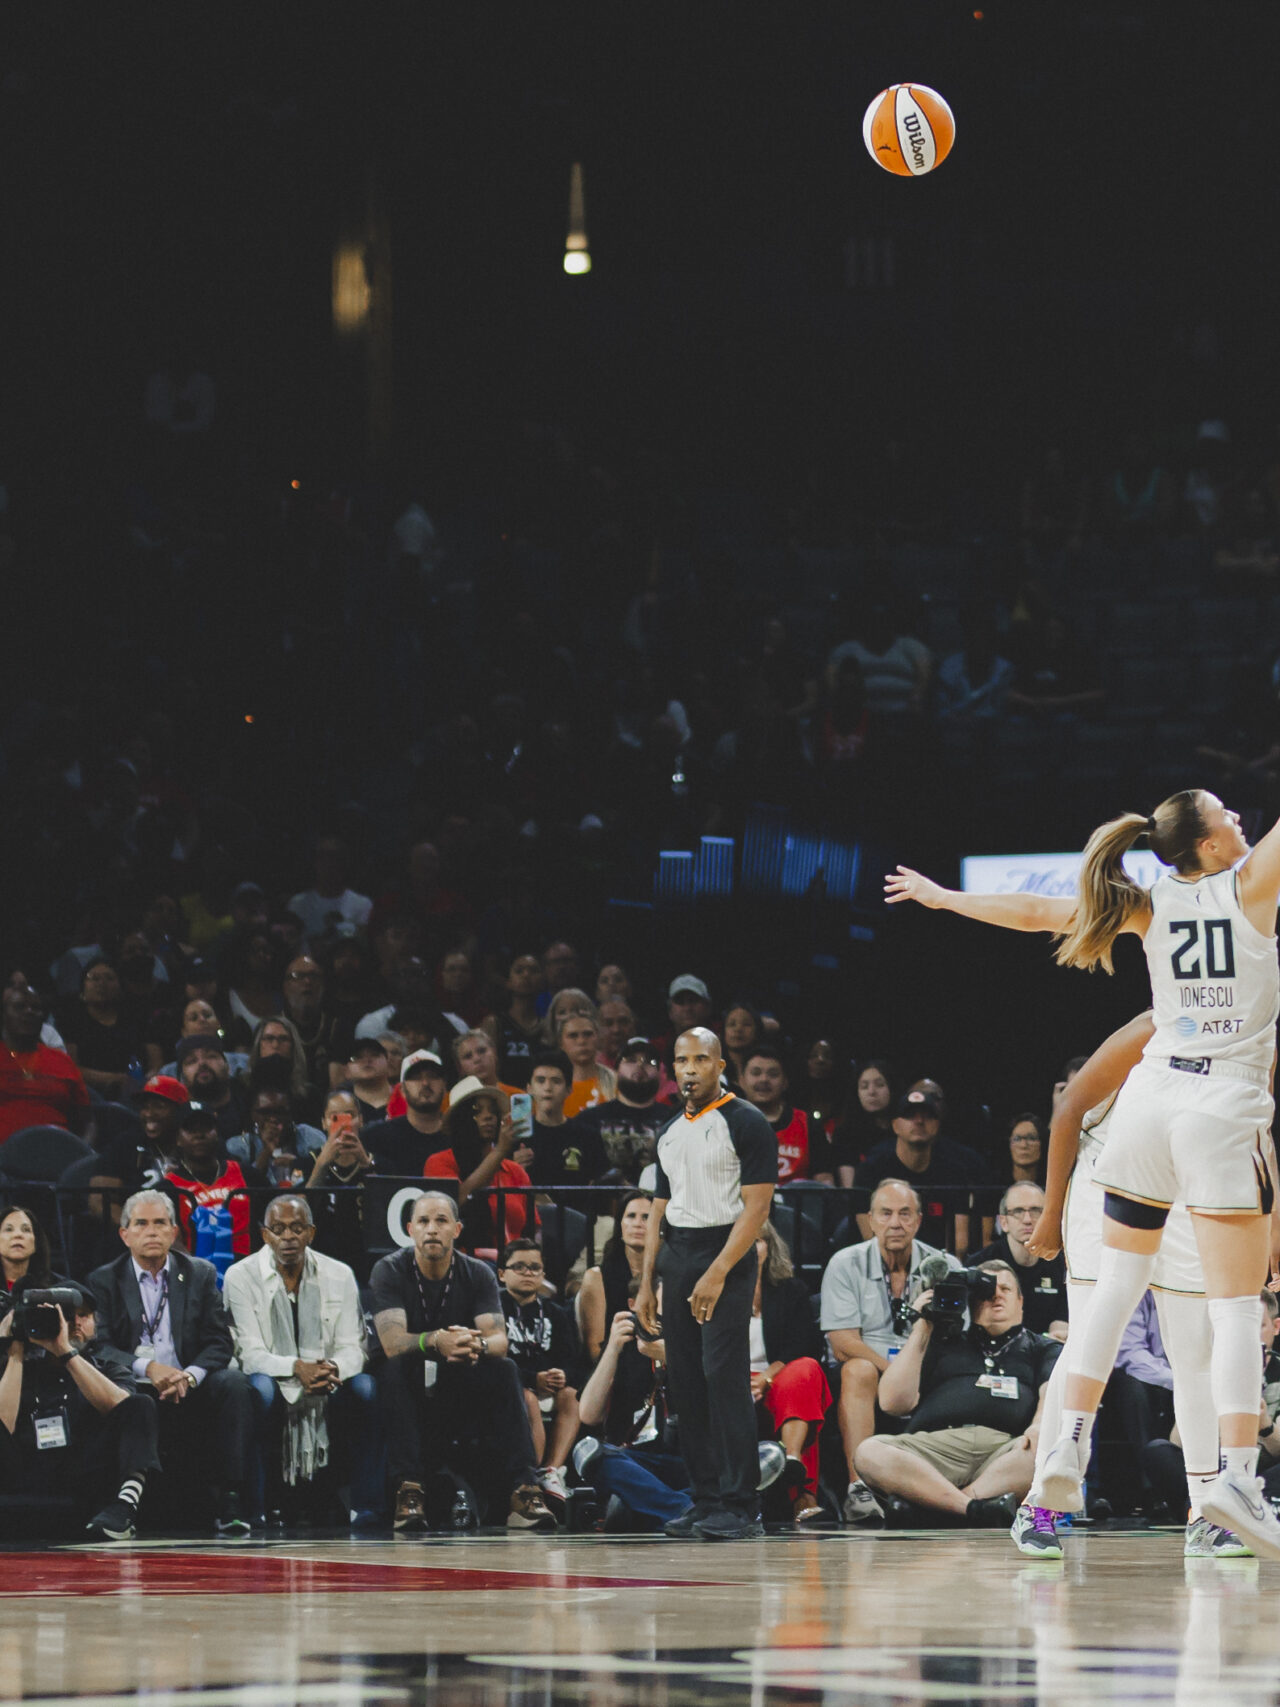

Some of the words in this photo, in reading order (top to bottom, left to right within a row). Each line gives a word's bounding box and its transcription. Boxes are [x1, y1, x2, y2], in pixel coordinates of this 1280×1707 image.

[903, 112, 926, 169] Wilson
[1169, 919, 1236, 979] 20
[1180, 986, 1233, 1008] IONESCU
[1202, 1019, 1243, 1034] AT&T
